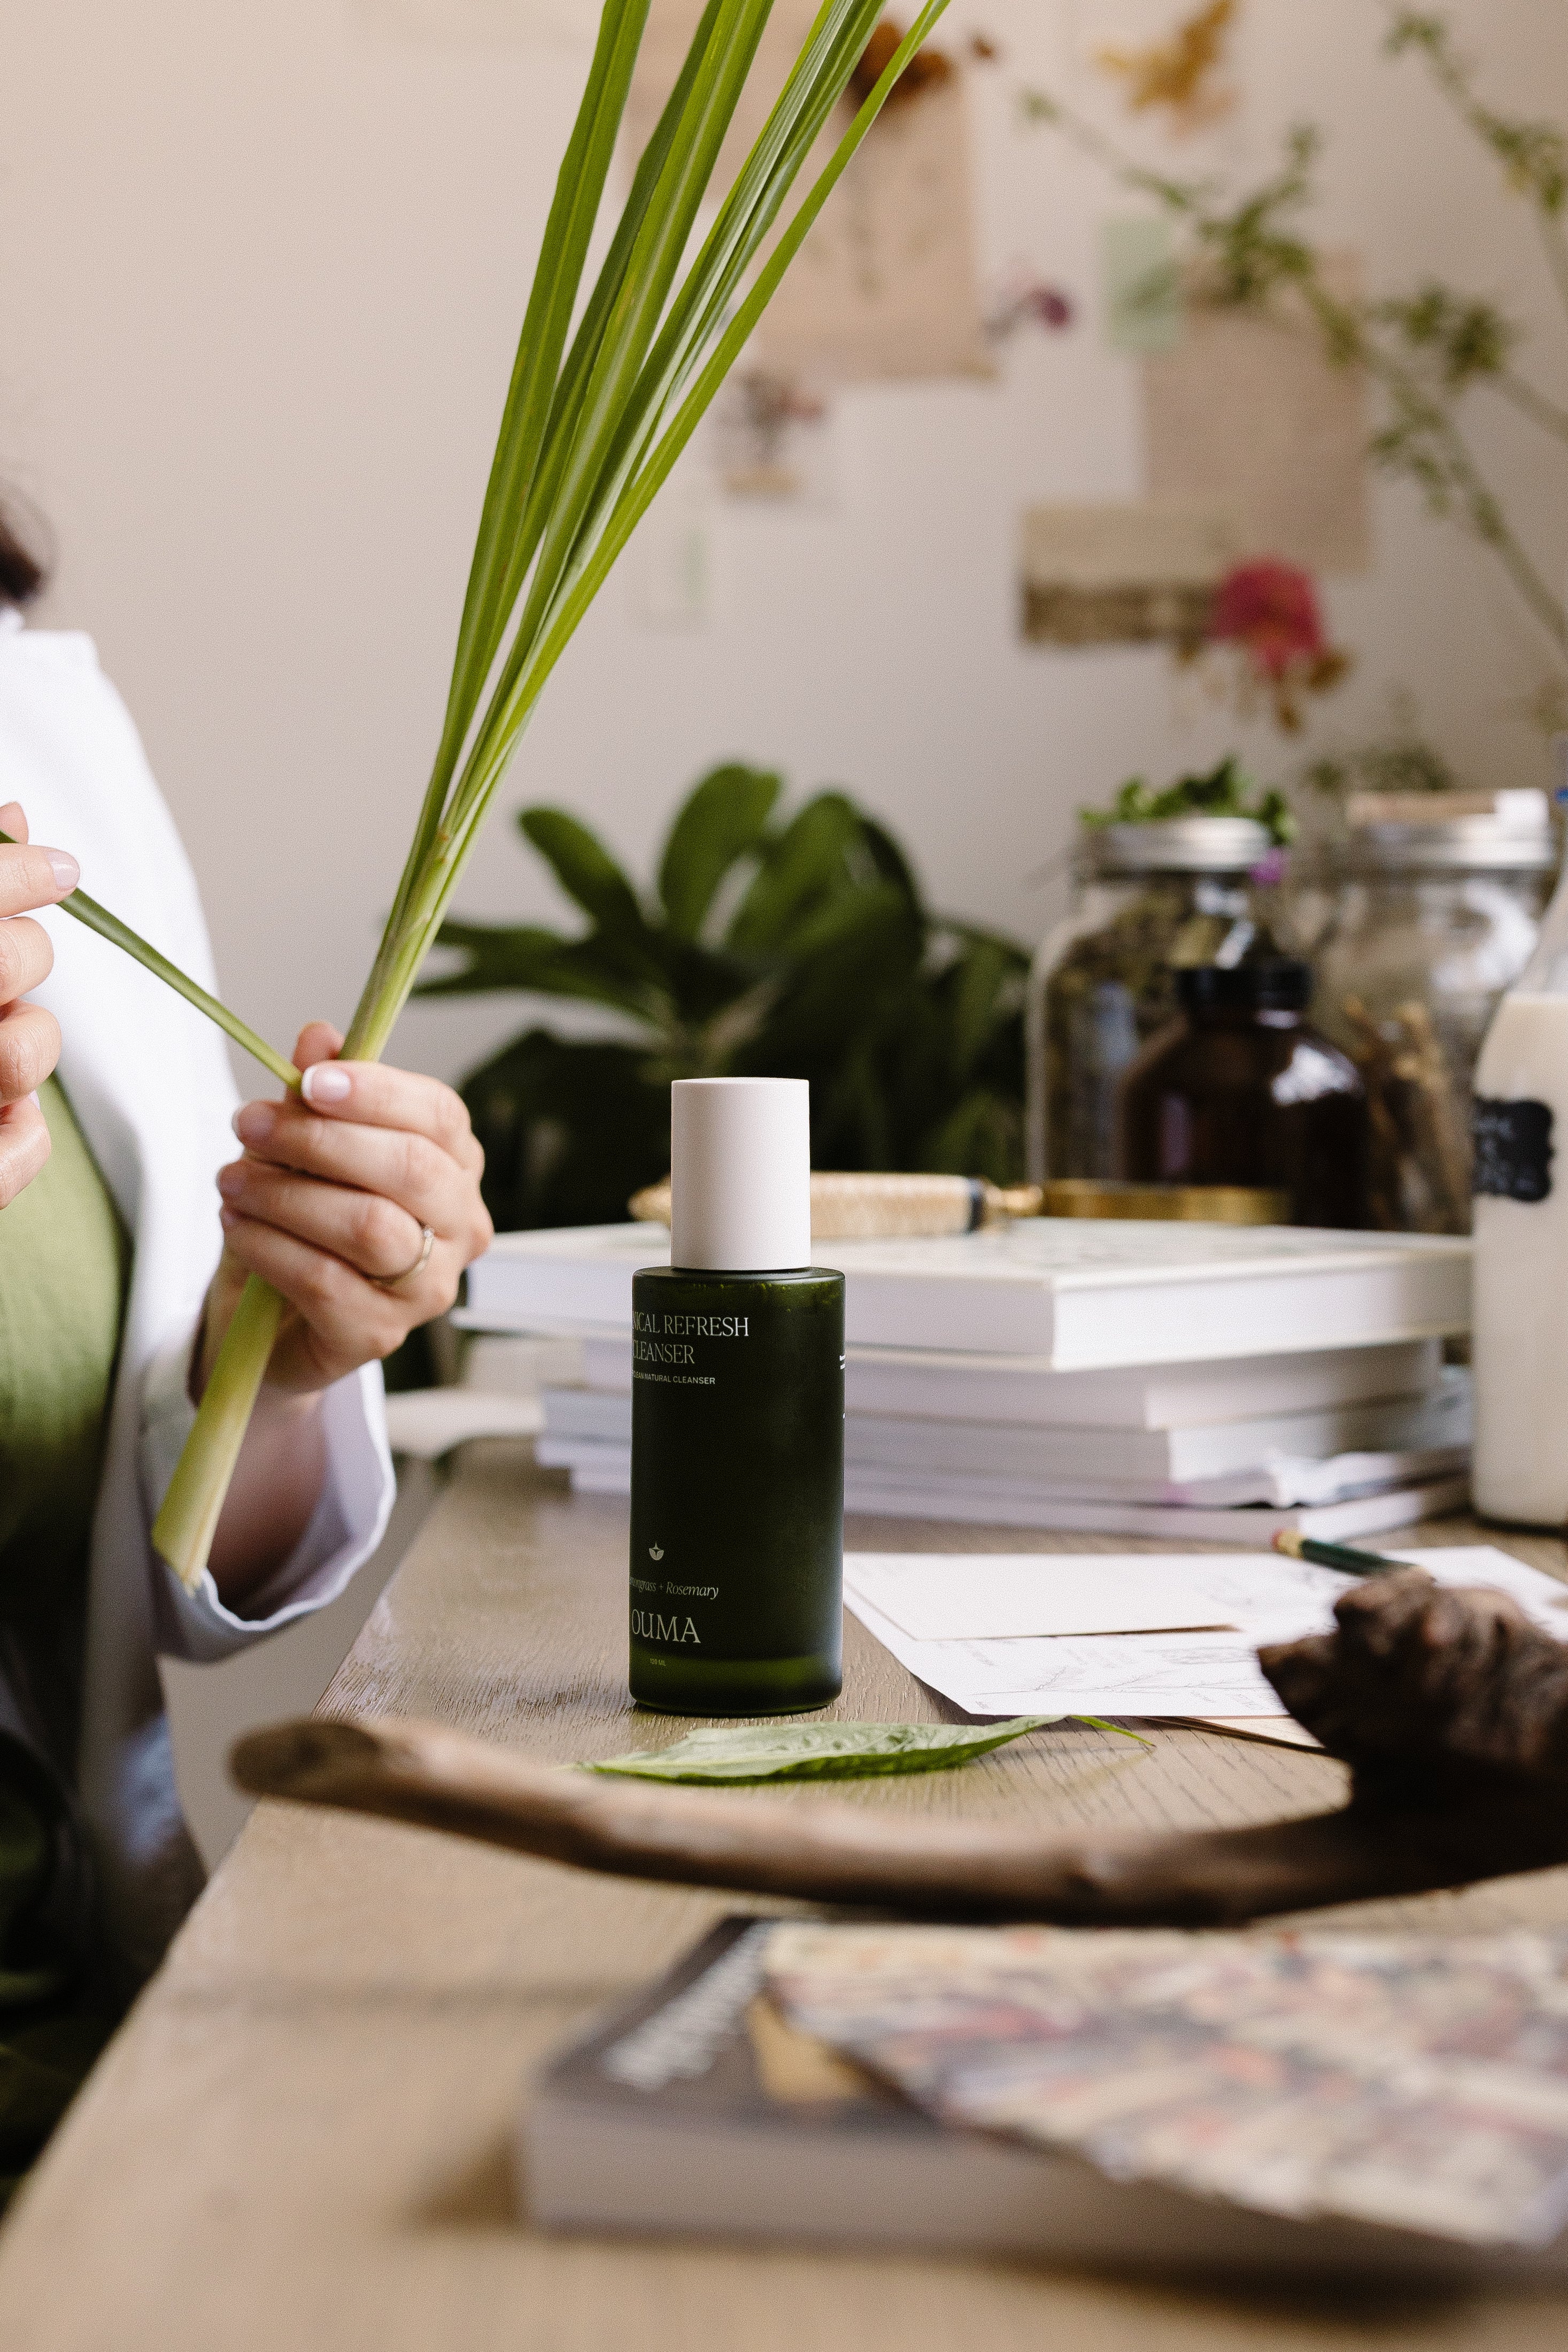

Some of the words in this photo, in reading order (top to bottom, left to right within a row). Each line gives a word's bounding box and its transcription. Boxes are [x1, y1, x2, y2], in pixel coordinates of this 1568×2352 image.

[664, 1314, 749, 1337] REFRESH
[632, 1339, 695, 1364] CLEANSER
[644, 1372, 671, 1383] NATURAL
[673, 1375, 715, 1385] CLEANSER
[666, 1582, 719, 1600] Rosemary
[631, 1608, 701, 1644] OUMA
